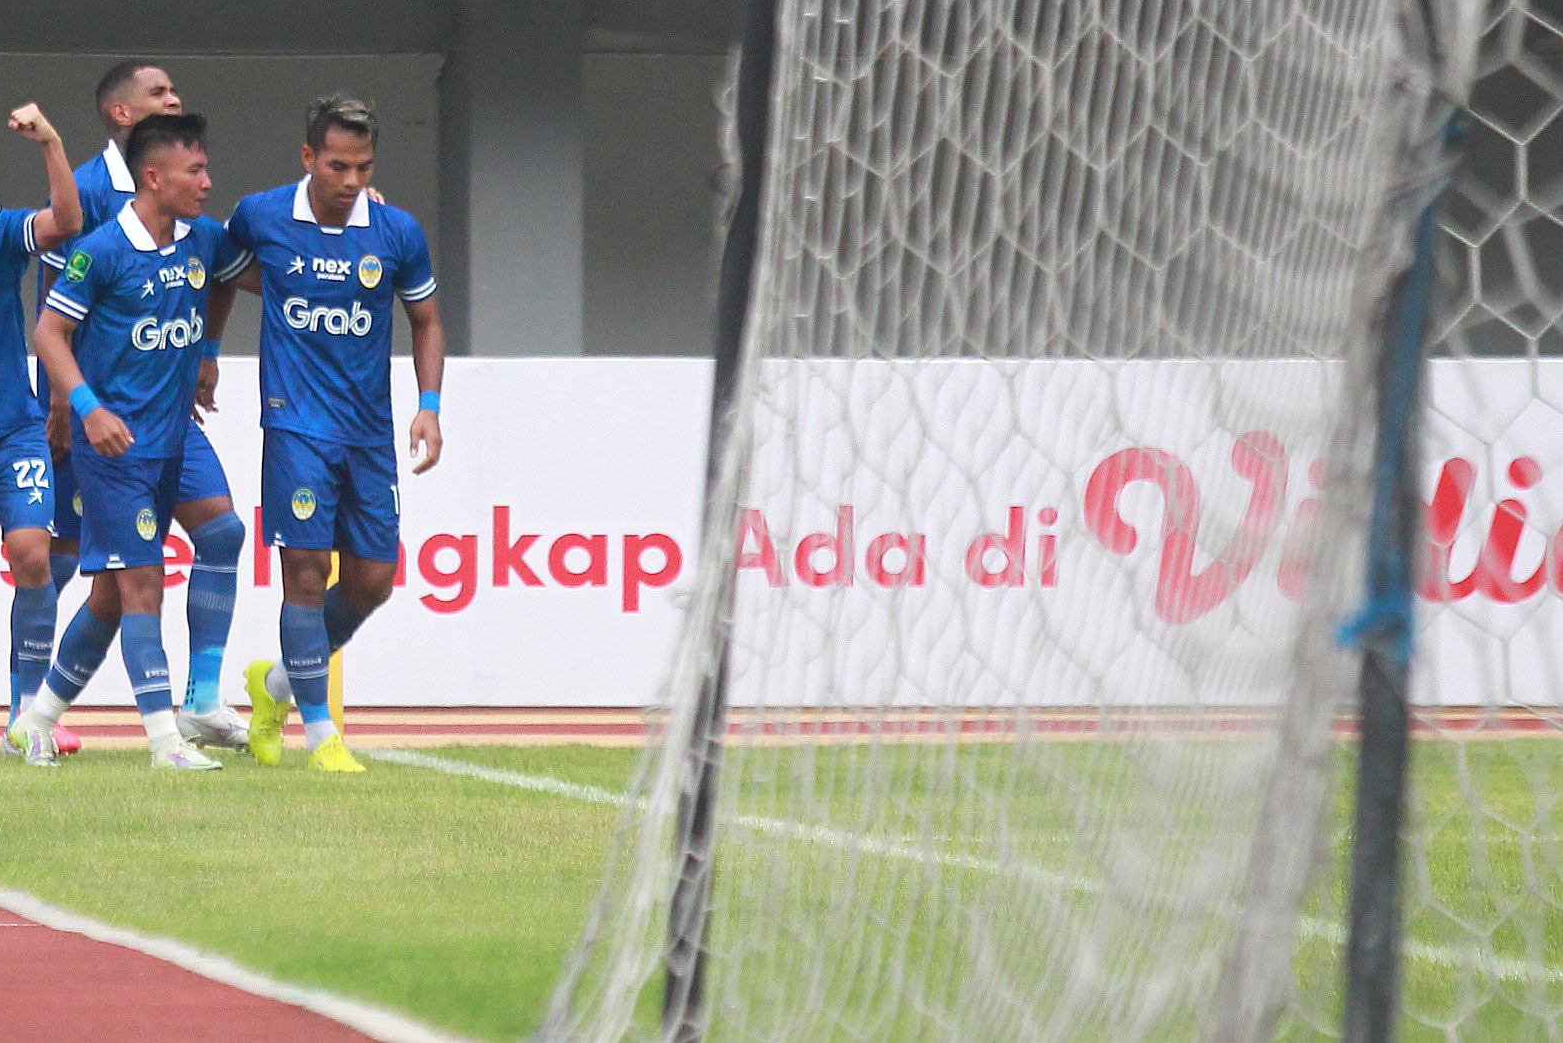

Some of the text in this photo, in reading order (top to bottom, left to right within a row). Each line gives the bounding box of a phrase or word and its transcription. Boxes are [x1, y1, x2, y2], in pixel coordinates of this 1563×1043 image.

[312, 258, 351, 274] nex
[132, 307, 204, 351] Grab
[283, 296, 372, 337] Grab
[12, 459, 50, 489] 22
[734, 505, 928, 589] Ada
[963, 504, 1060, 589] di
